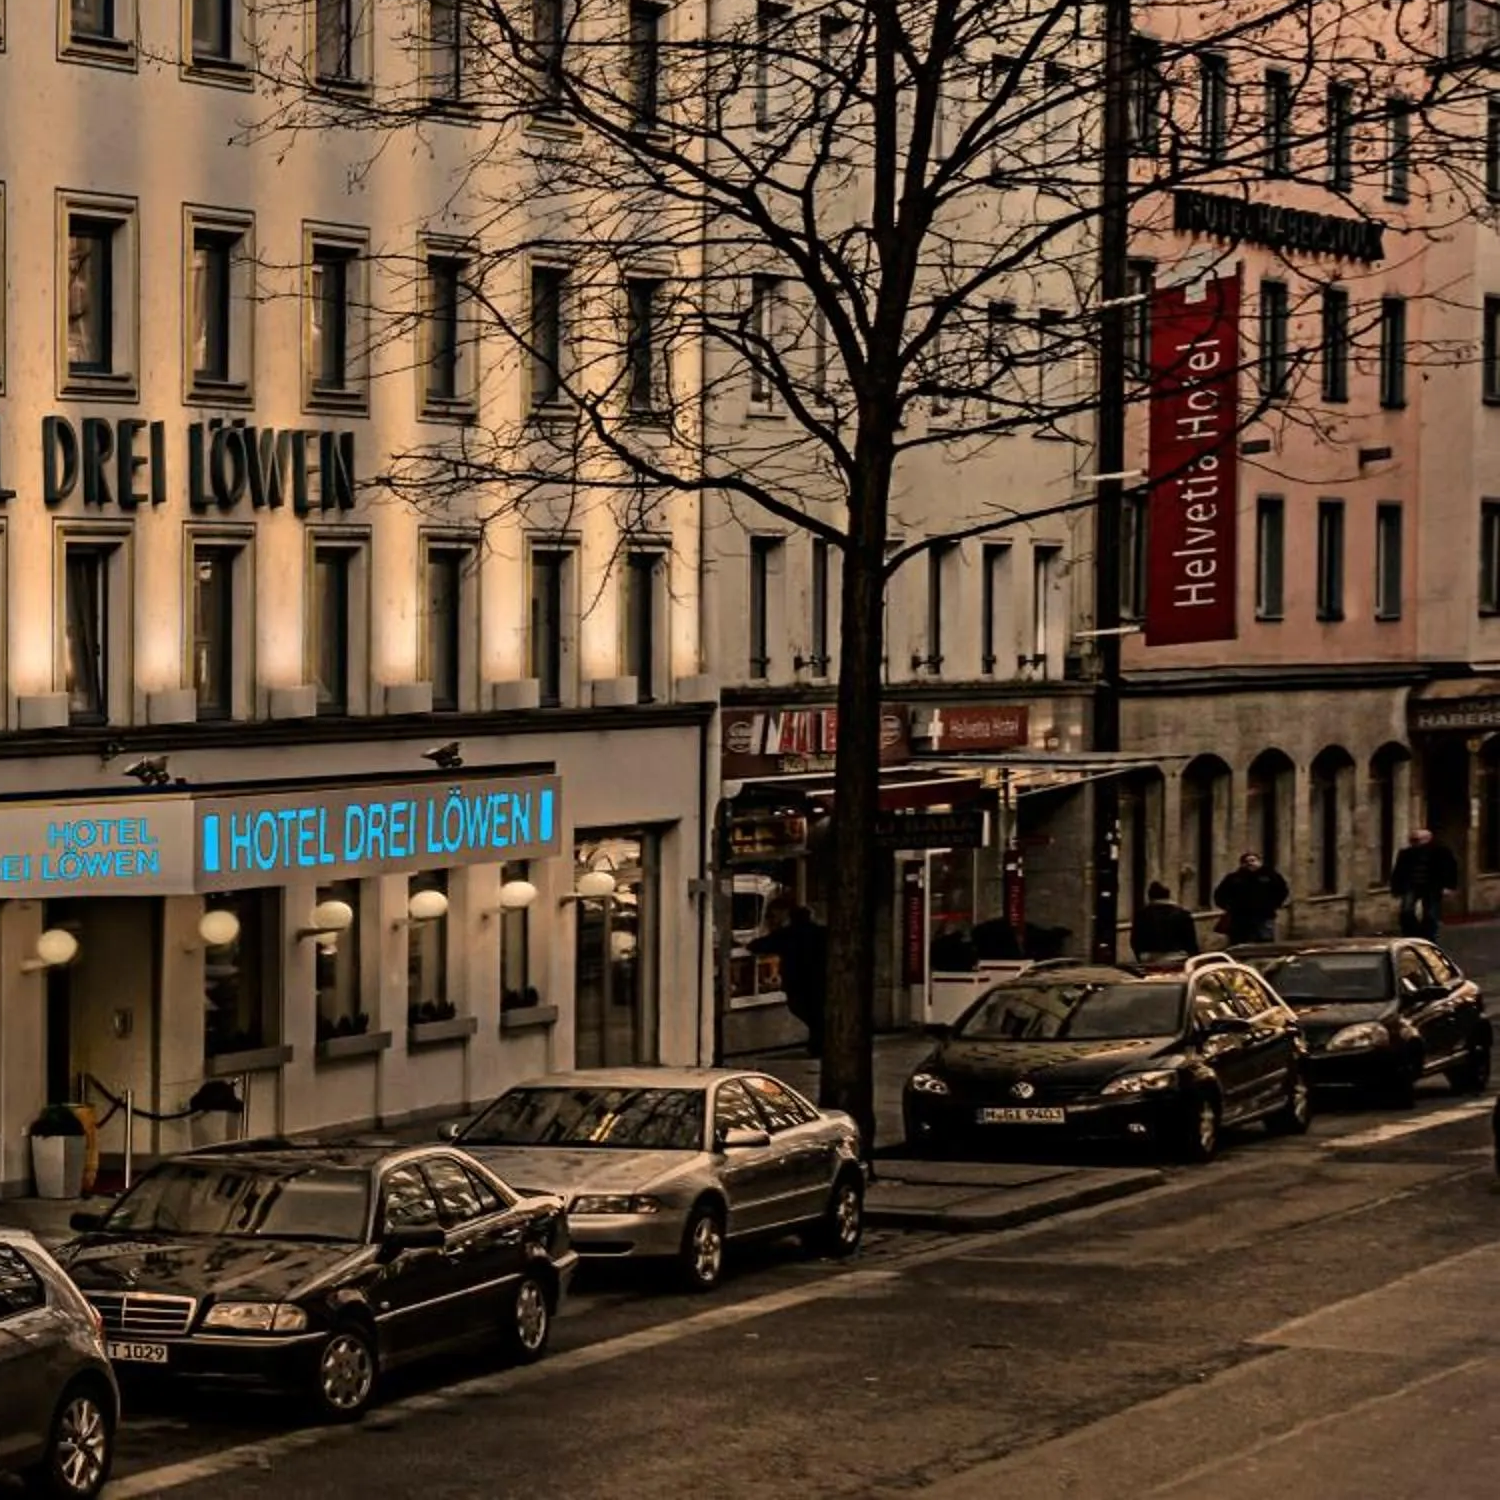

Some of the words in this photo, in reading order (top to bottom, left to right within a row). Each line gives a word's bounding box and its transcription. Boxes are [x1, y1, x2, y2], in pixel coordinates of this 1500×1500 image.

[1174, 338, 1221, 440] Hotel
[42, 415, 167, 509] DREI
[189, 417, 357, 518] LÖWEN
[1171, 454, 1219, 607] Helvetia
[41, 847, 161, 881] LÖWEN
[48, 817, 159, 848] HOTEL
[229, 806, 336, 871] HOTEL
[343, 800, 417, 861] DREI
[426, 785, 531, 853] LÖWEN
[124, 1345, 165, 1360] 1029
